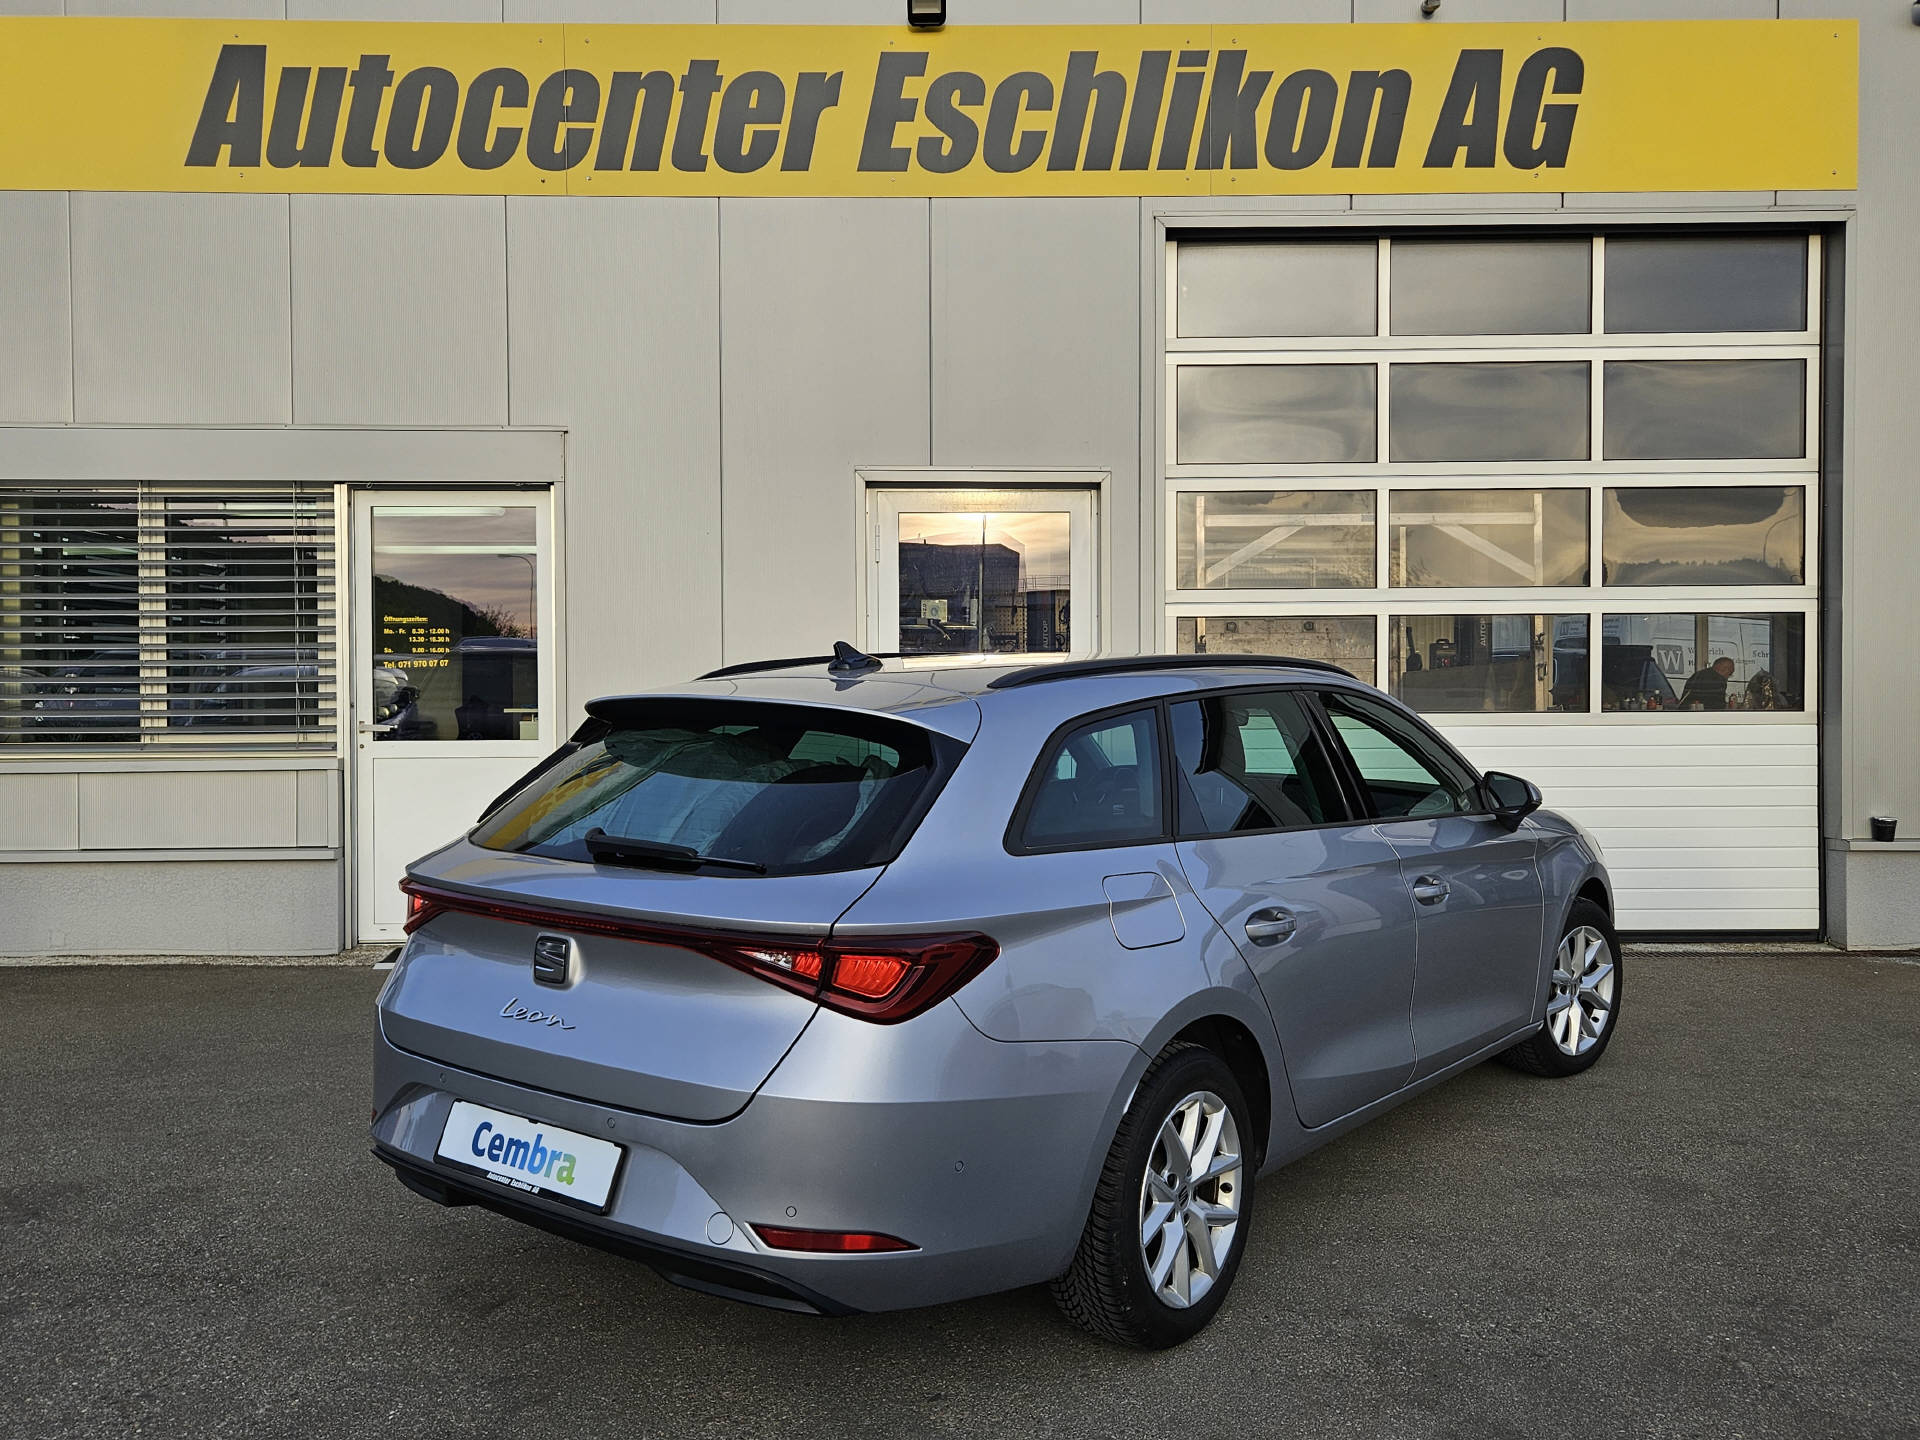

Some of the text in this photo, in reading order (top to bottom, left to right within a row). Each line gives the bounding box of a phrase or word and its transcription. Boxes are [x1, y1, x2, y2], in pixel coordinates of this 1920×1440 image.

[184, 44, 1584, 174] Autocenter Eschlikon AG
[384, 659, 449, 669] Tel. 071 970 07 07
[1657, 649, 1683, 672] W
[500, 997, 576, 1030] Leon
[472, 1121, 577, 1186] Cembra
